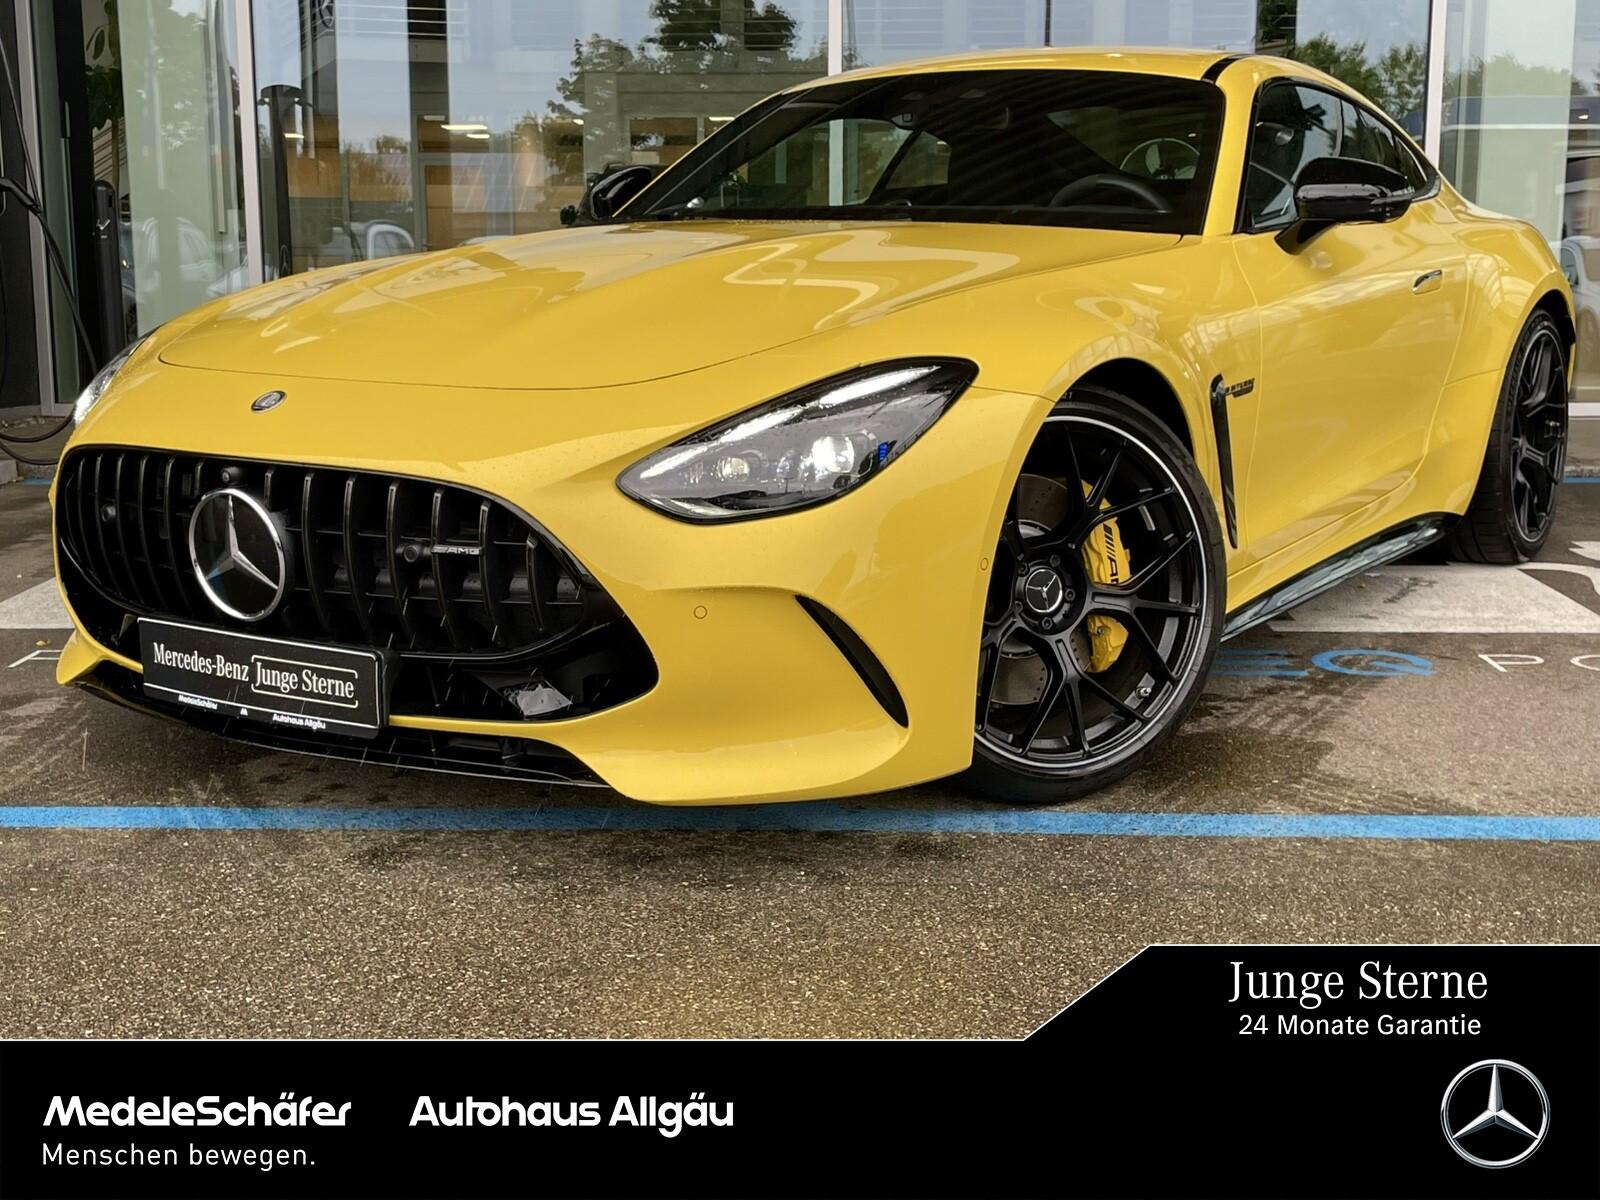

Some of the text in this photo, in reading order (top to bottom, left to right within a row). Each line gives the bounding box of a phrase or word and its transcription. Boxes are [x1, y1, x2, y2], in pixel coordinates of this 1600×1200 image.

[153, 642, 355, 699] Mercedes-Benz Junge Sterne
